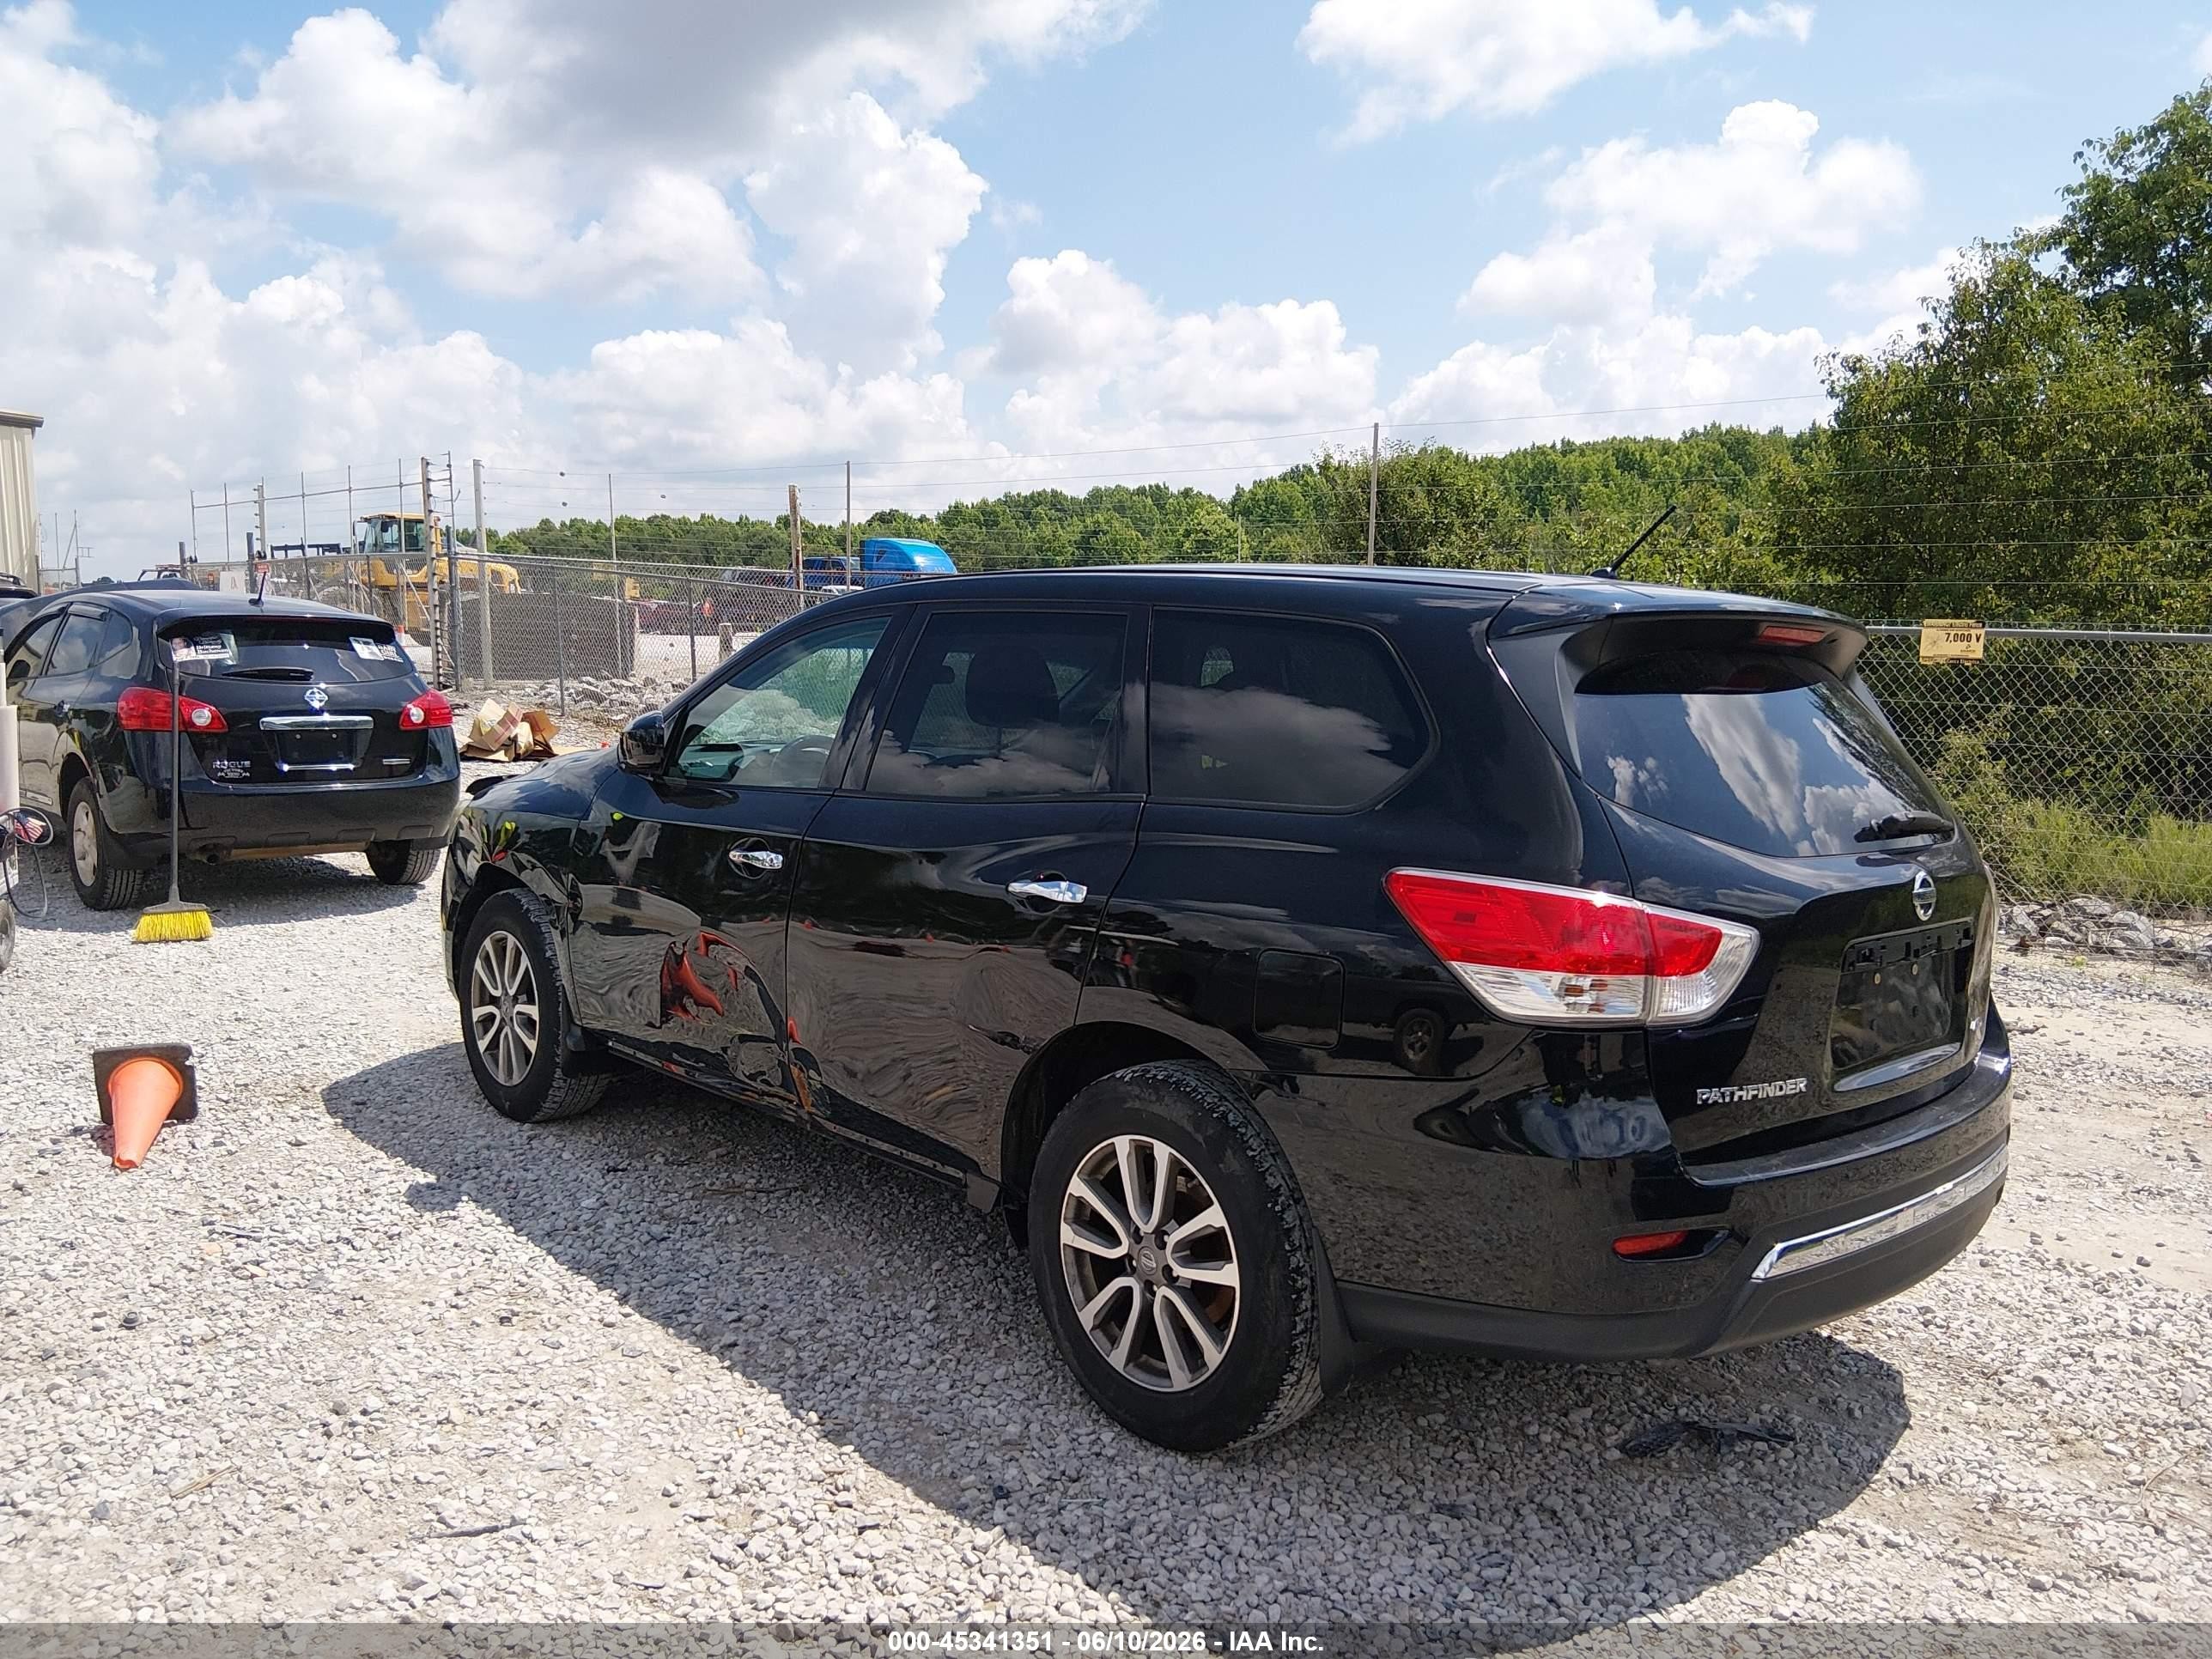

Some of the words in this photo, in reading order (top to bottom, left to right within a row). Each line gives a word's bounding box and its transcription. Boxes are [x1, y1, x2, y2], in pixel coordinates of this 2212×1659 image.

[1945, 632, 1972, 644] 7,000
[1976, 633, 1982, 643] V
[212, 760, 251, 769] ROGUE
[1696, 1078, 1808, 1104] PATHFINDER
